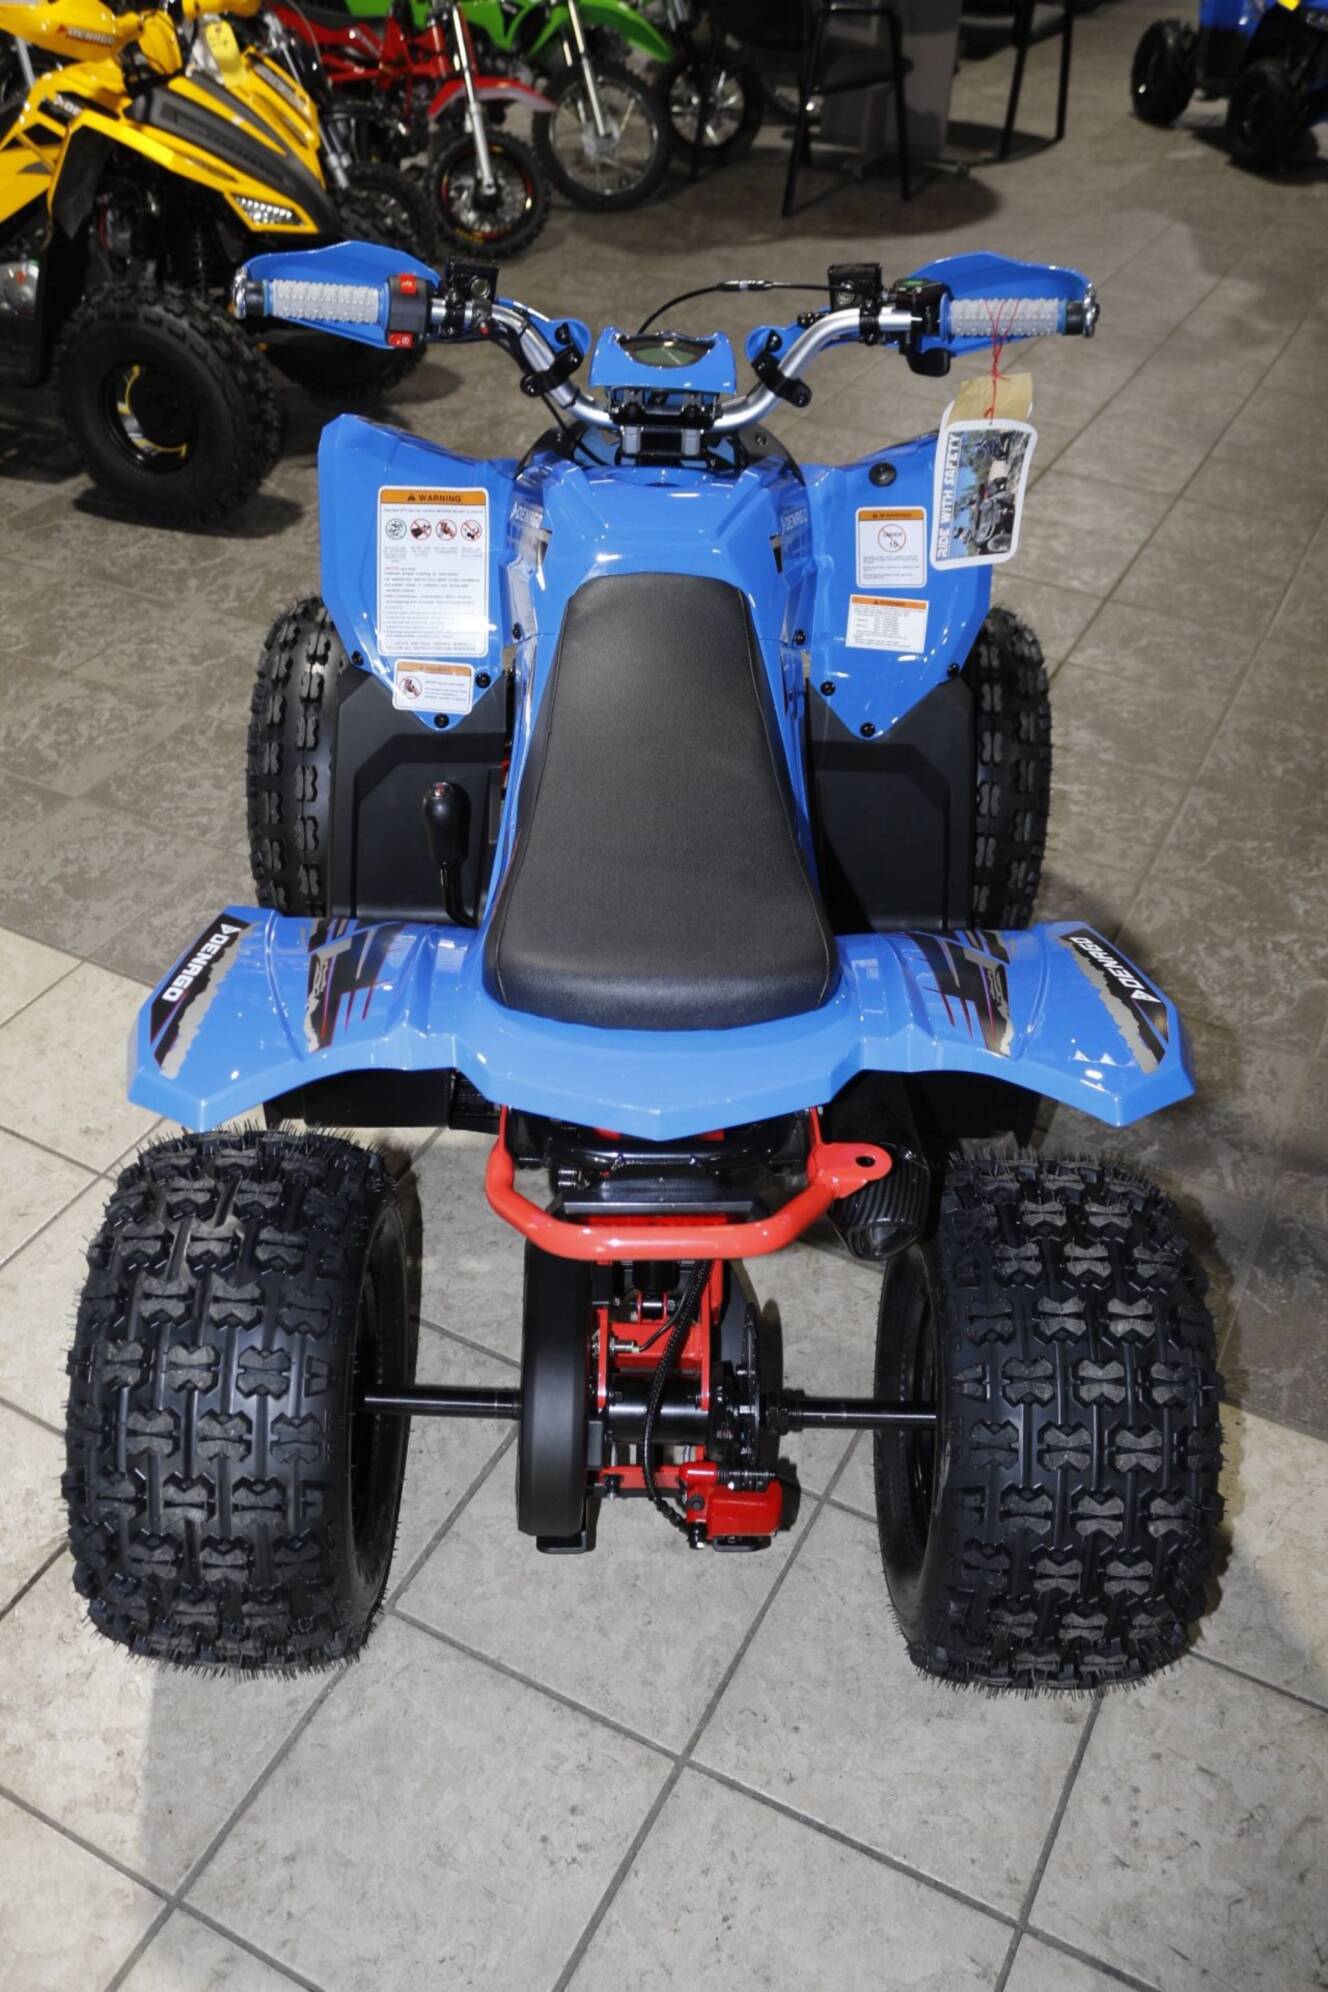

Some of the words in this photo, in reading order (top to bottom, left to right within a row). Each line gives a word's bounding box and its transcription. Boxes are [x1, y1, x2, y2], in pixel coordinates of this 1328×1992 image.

[943, 434, 961, 486] SAFETY
[418, 493, 462, 503] WARNING
[940, 489, 955, 524] WITH
[937, 527, 951, 557] RIDE
[162, 933, 229, 1002] DENAGO
[1070, 936, 1145, 990] DENAGO
